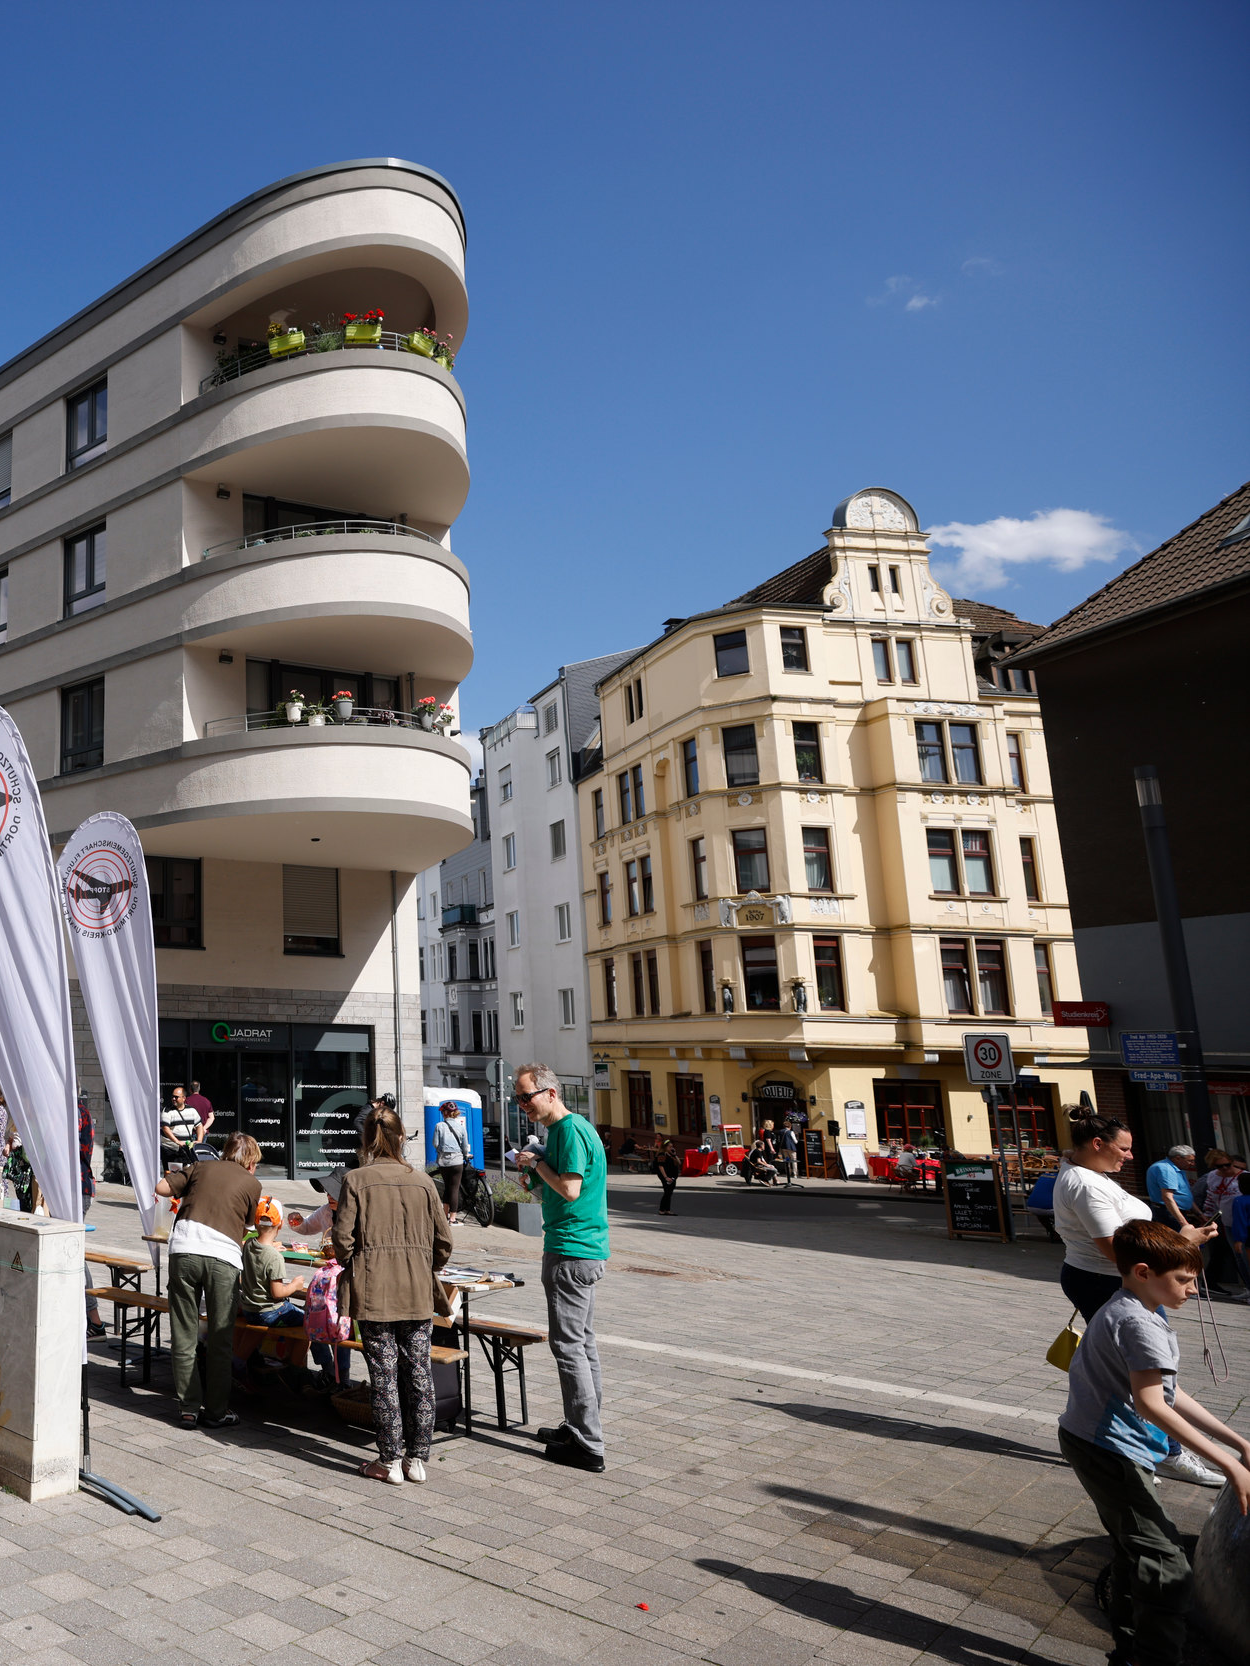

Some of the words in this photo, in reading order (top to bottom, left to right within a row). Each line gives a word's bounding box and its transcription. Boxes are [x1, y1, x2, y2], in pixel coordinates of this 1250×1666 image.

[745, 913, 765, 921] 1907
[212, 1022, 273, 1043] QUADRAT
[979, 1047, 997, 1061] 30
[980, 1070, 1002, 1079] ZONE
[1133, 1071, 1177, 1081] Fred-Ape-Weg
[764, 1085, 794, 1098] QUEUE
